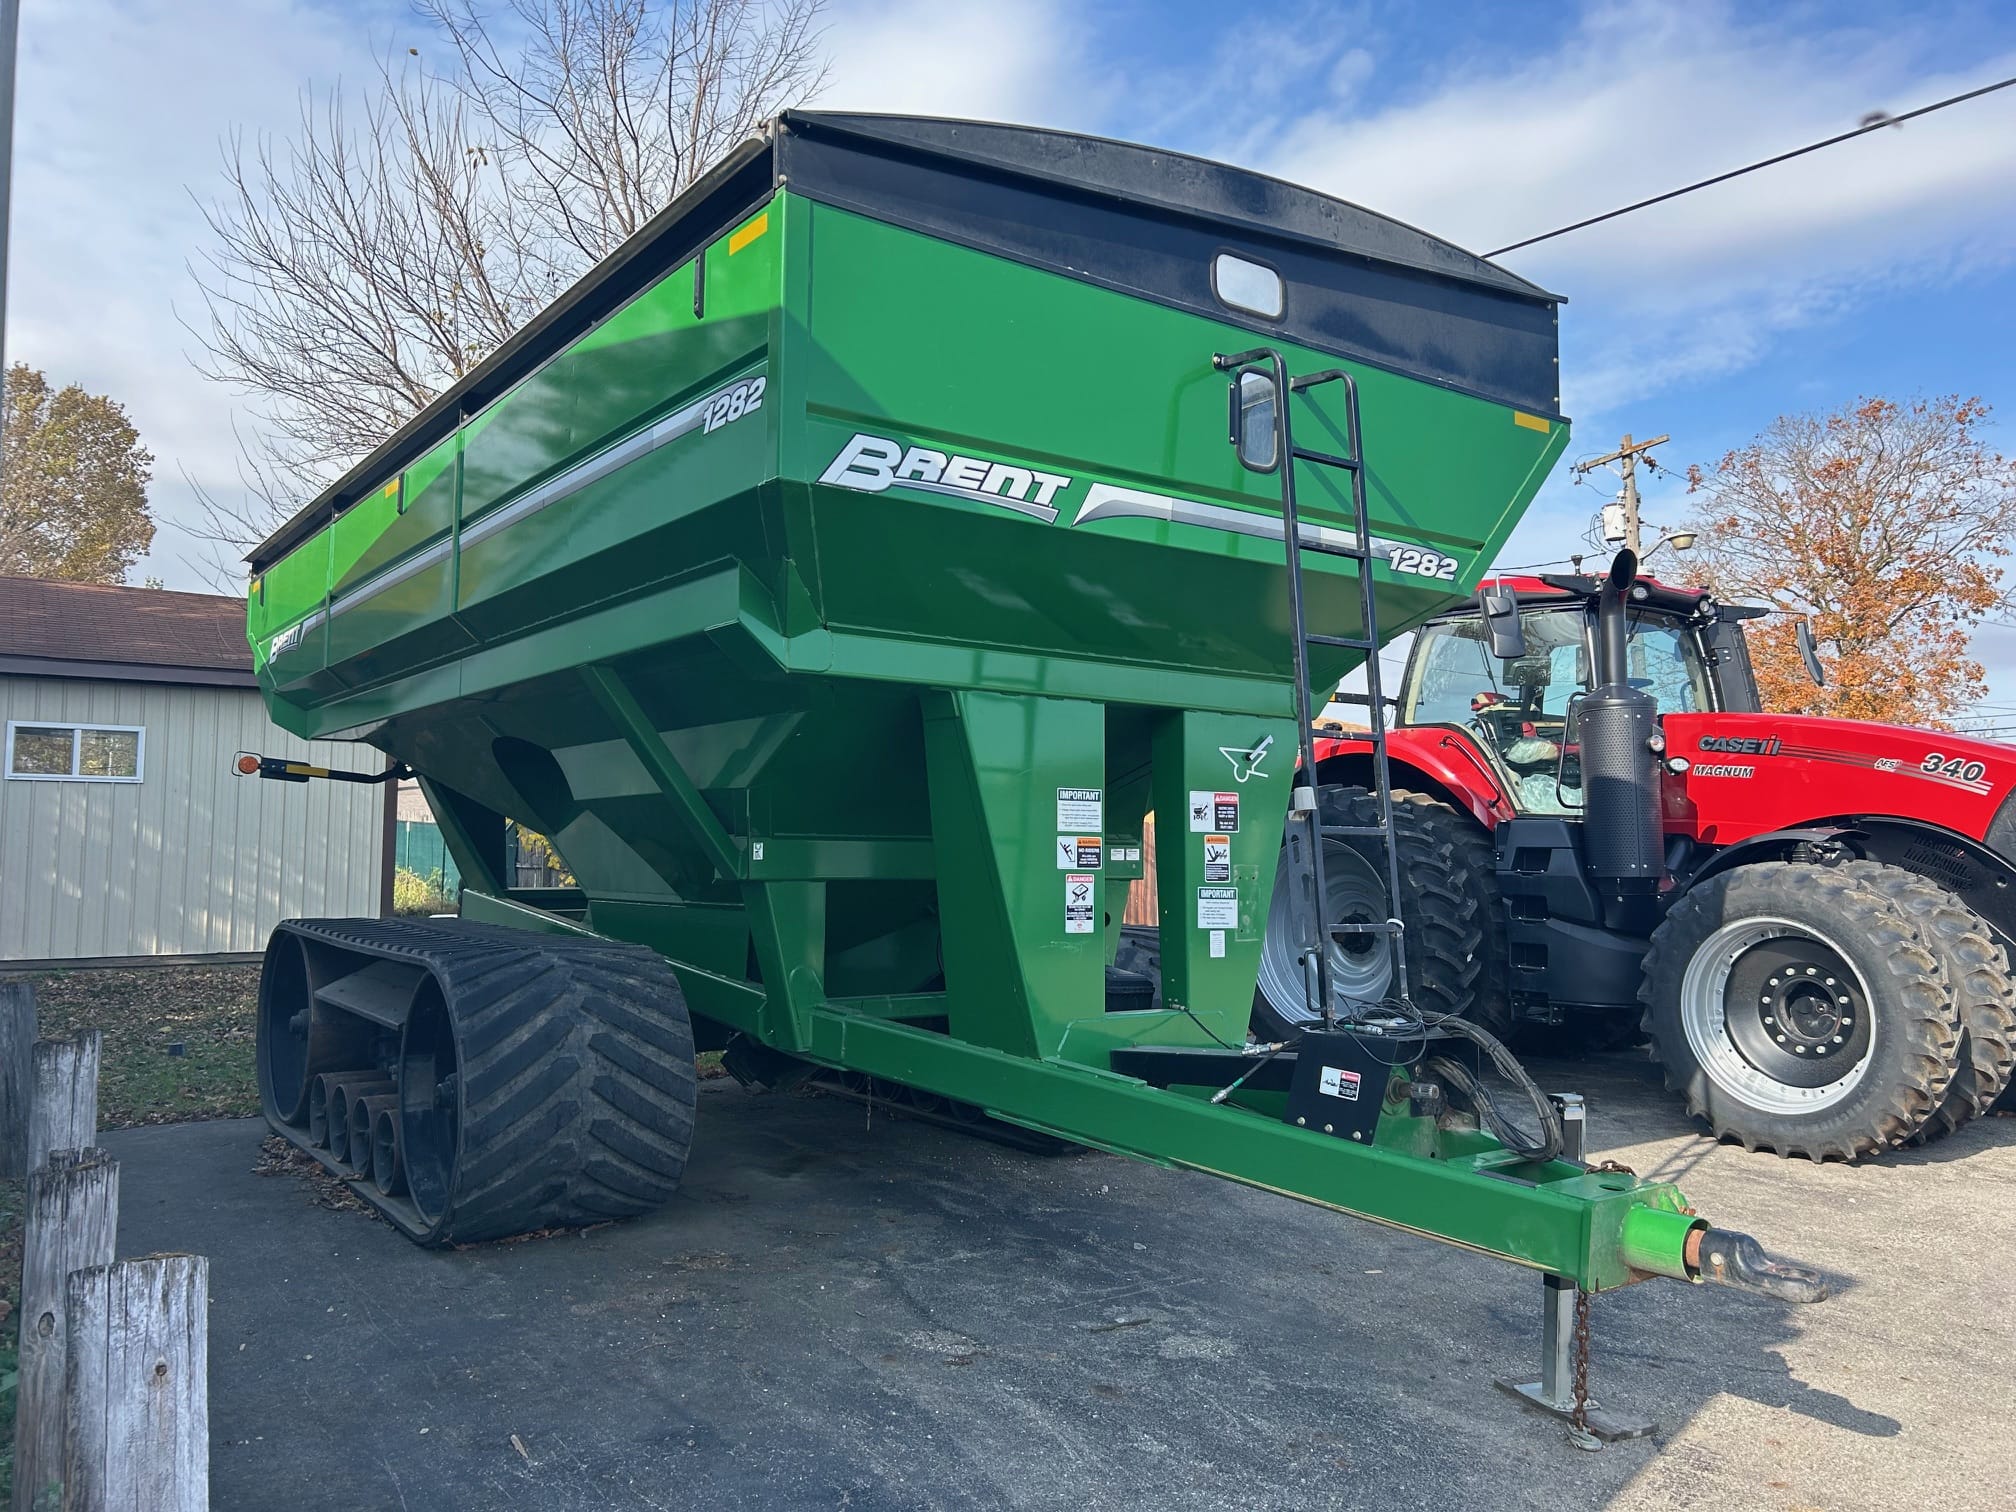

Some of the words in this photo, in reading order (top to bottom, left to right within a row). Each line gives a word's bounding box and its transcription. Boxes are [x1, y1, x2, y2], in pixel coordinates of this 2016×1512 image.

[702, 376, 767, 435] 1282
[816, 432, 1073, 508] BRENT
[1388, 546, 1459, 582] 1282
[1699, 735, 1758, 754] CASE
[1693, 764, 1755, 779] MAGNUM
[1920, 752, 1986, 783] 340
[1059, 790, 1099, 801] IMPORTANT
[1200, 889, 1235, 899] IMPORTANT
